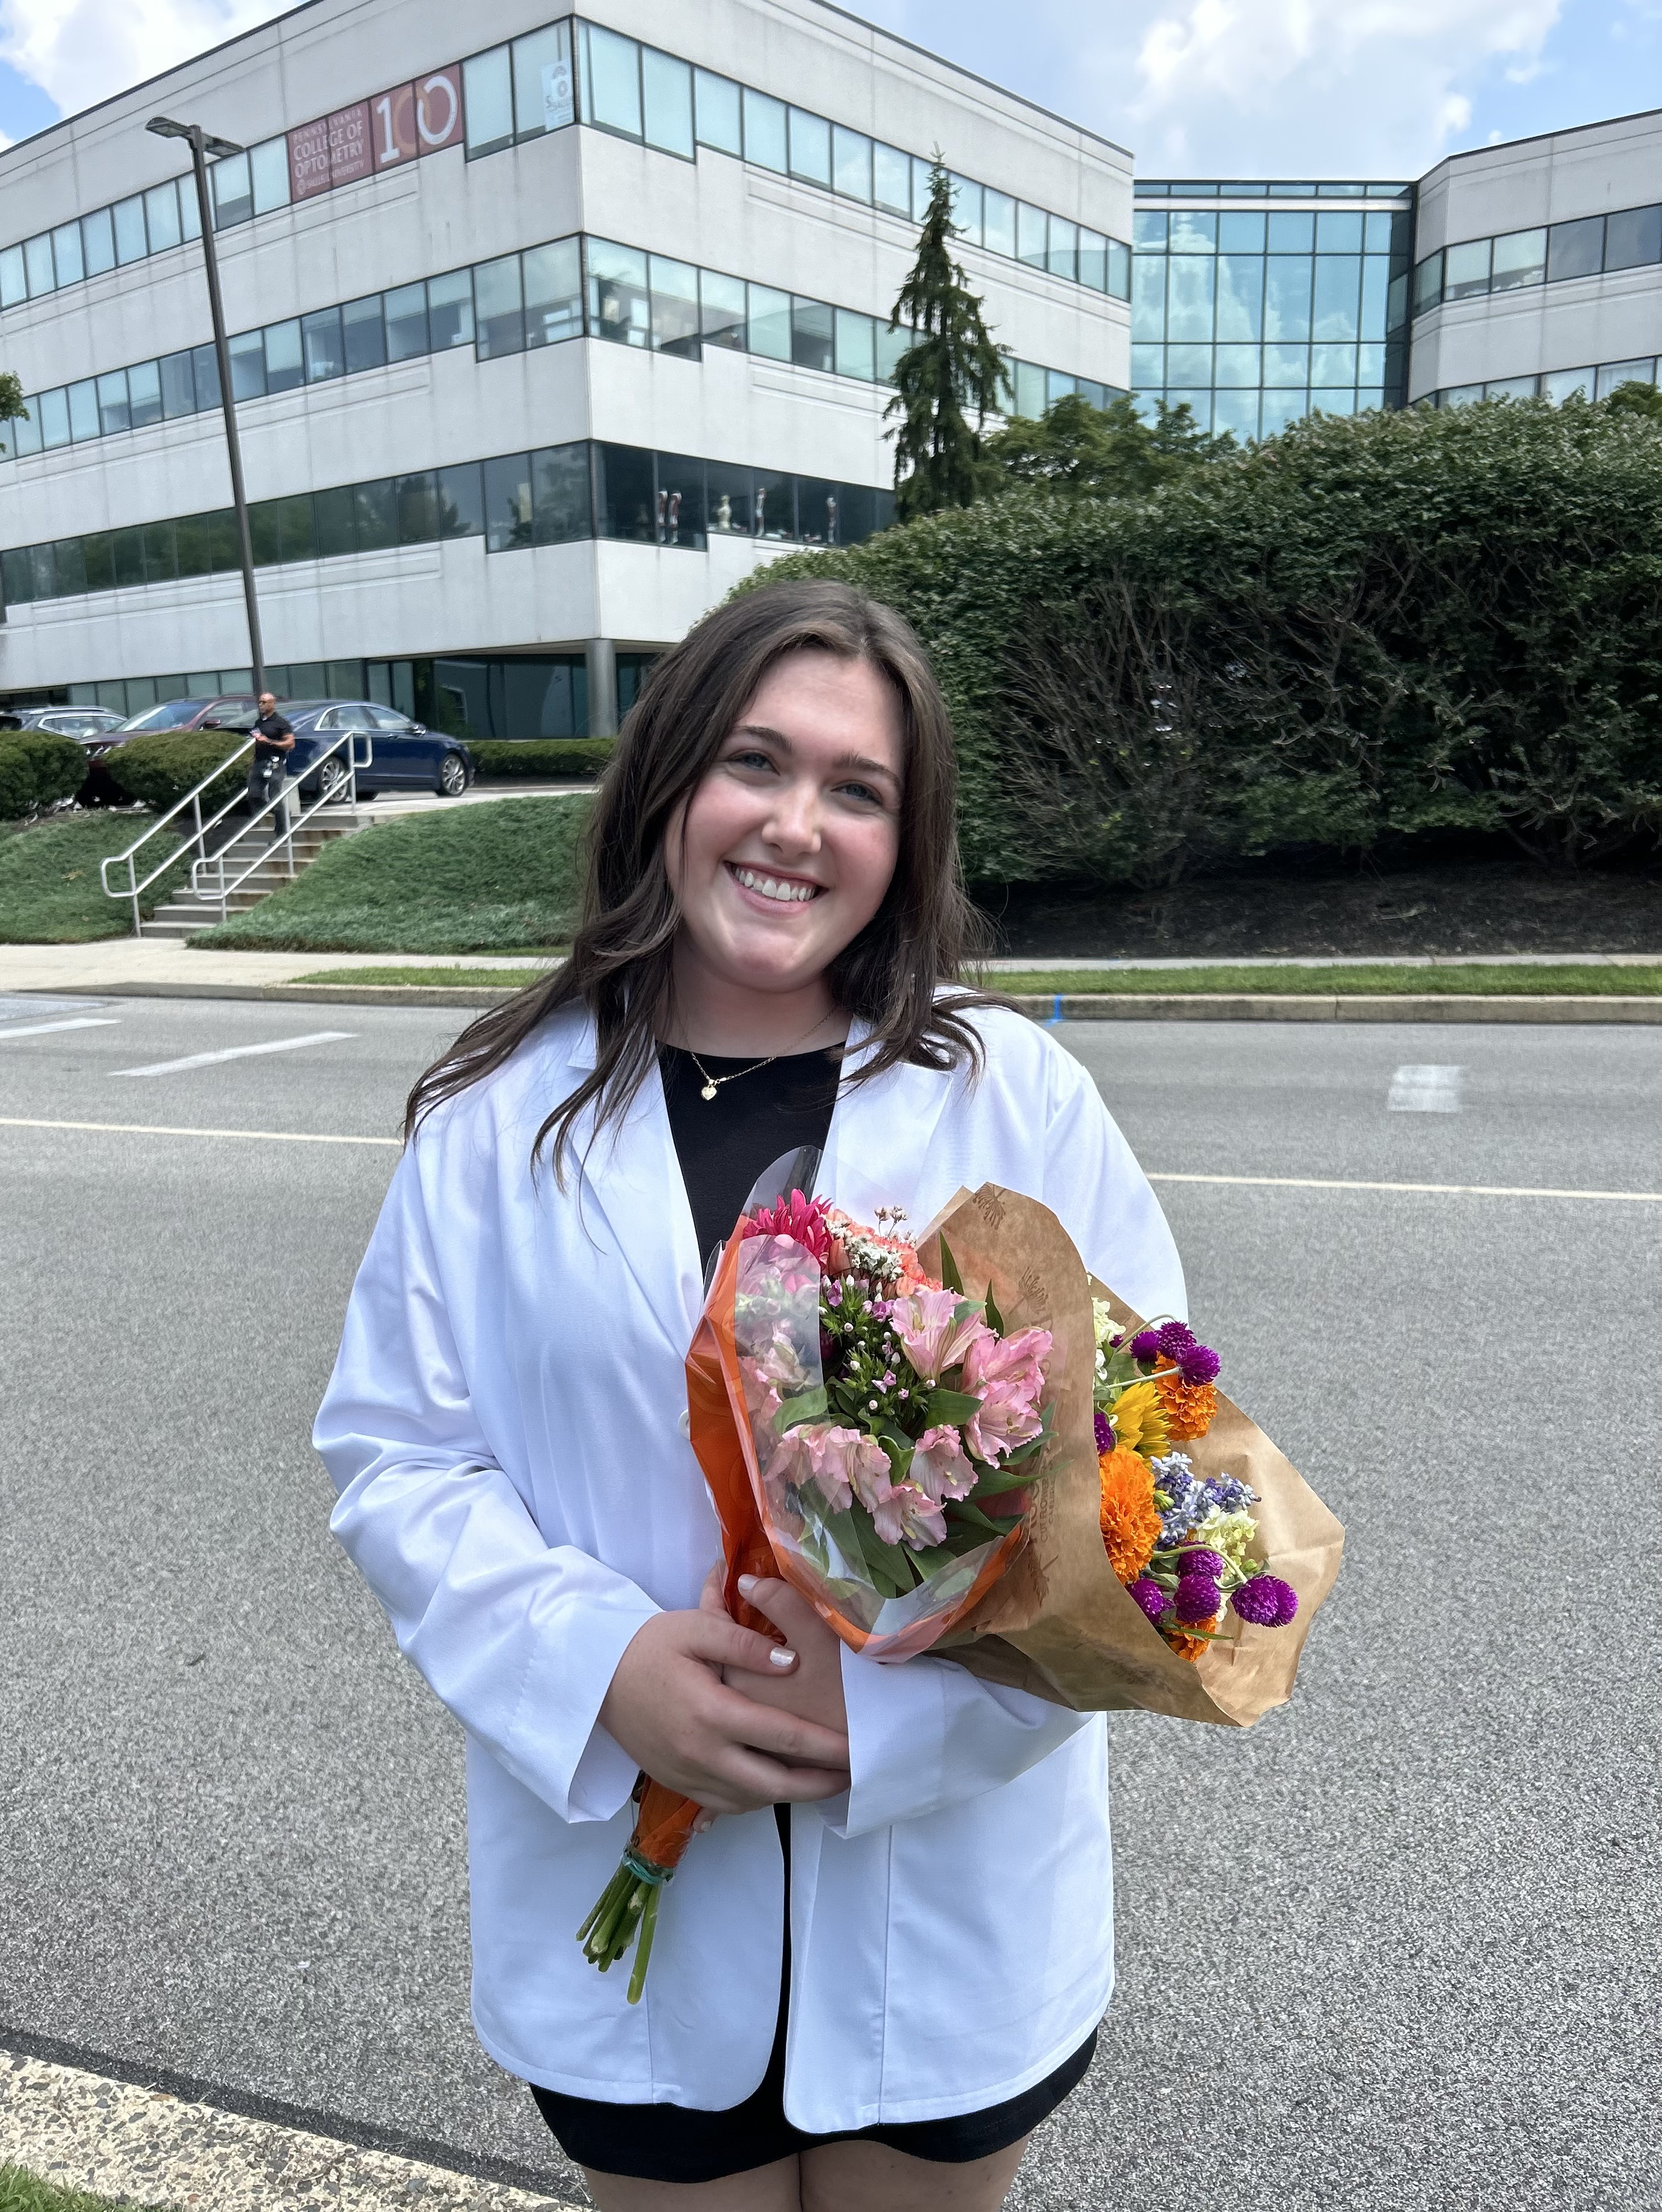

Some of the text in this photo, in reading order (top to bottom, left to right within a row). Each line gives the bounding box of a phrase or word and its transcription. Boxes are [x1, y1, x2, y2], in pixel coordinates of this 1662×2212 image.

[293, 120, 363, 161] COLLEGE OF
[294, 139, 364, 178] OPTOMETRY
